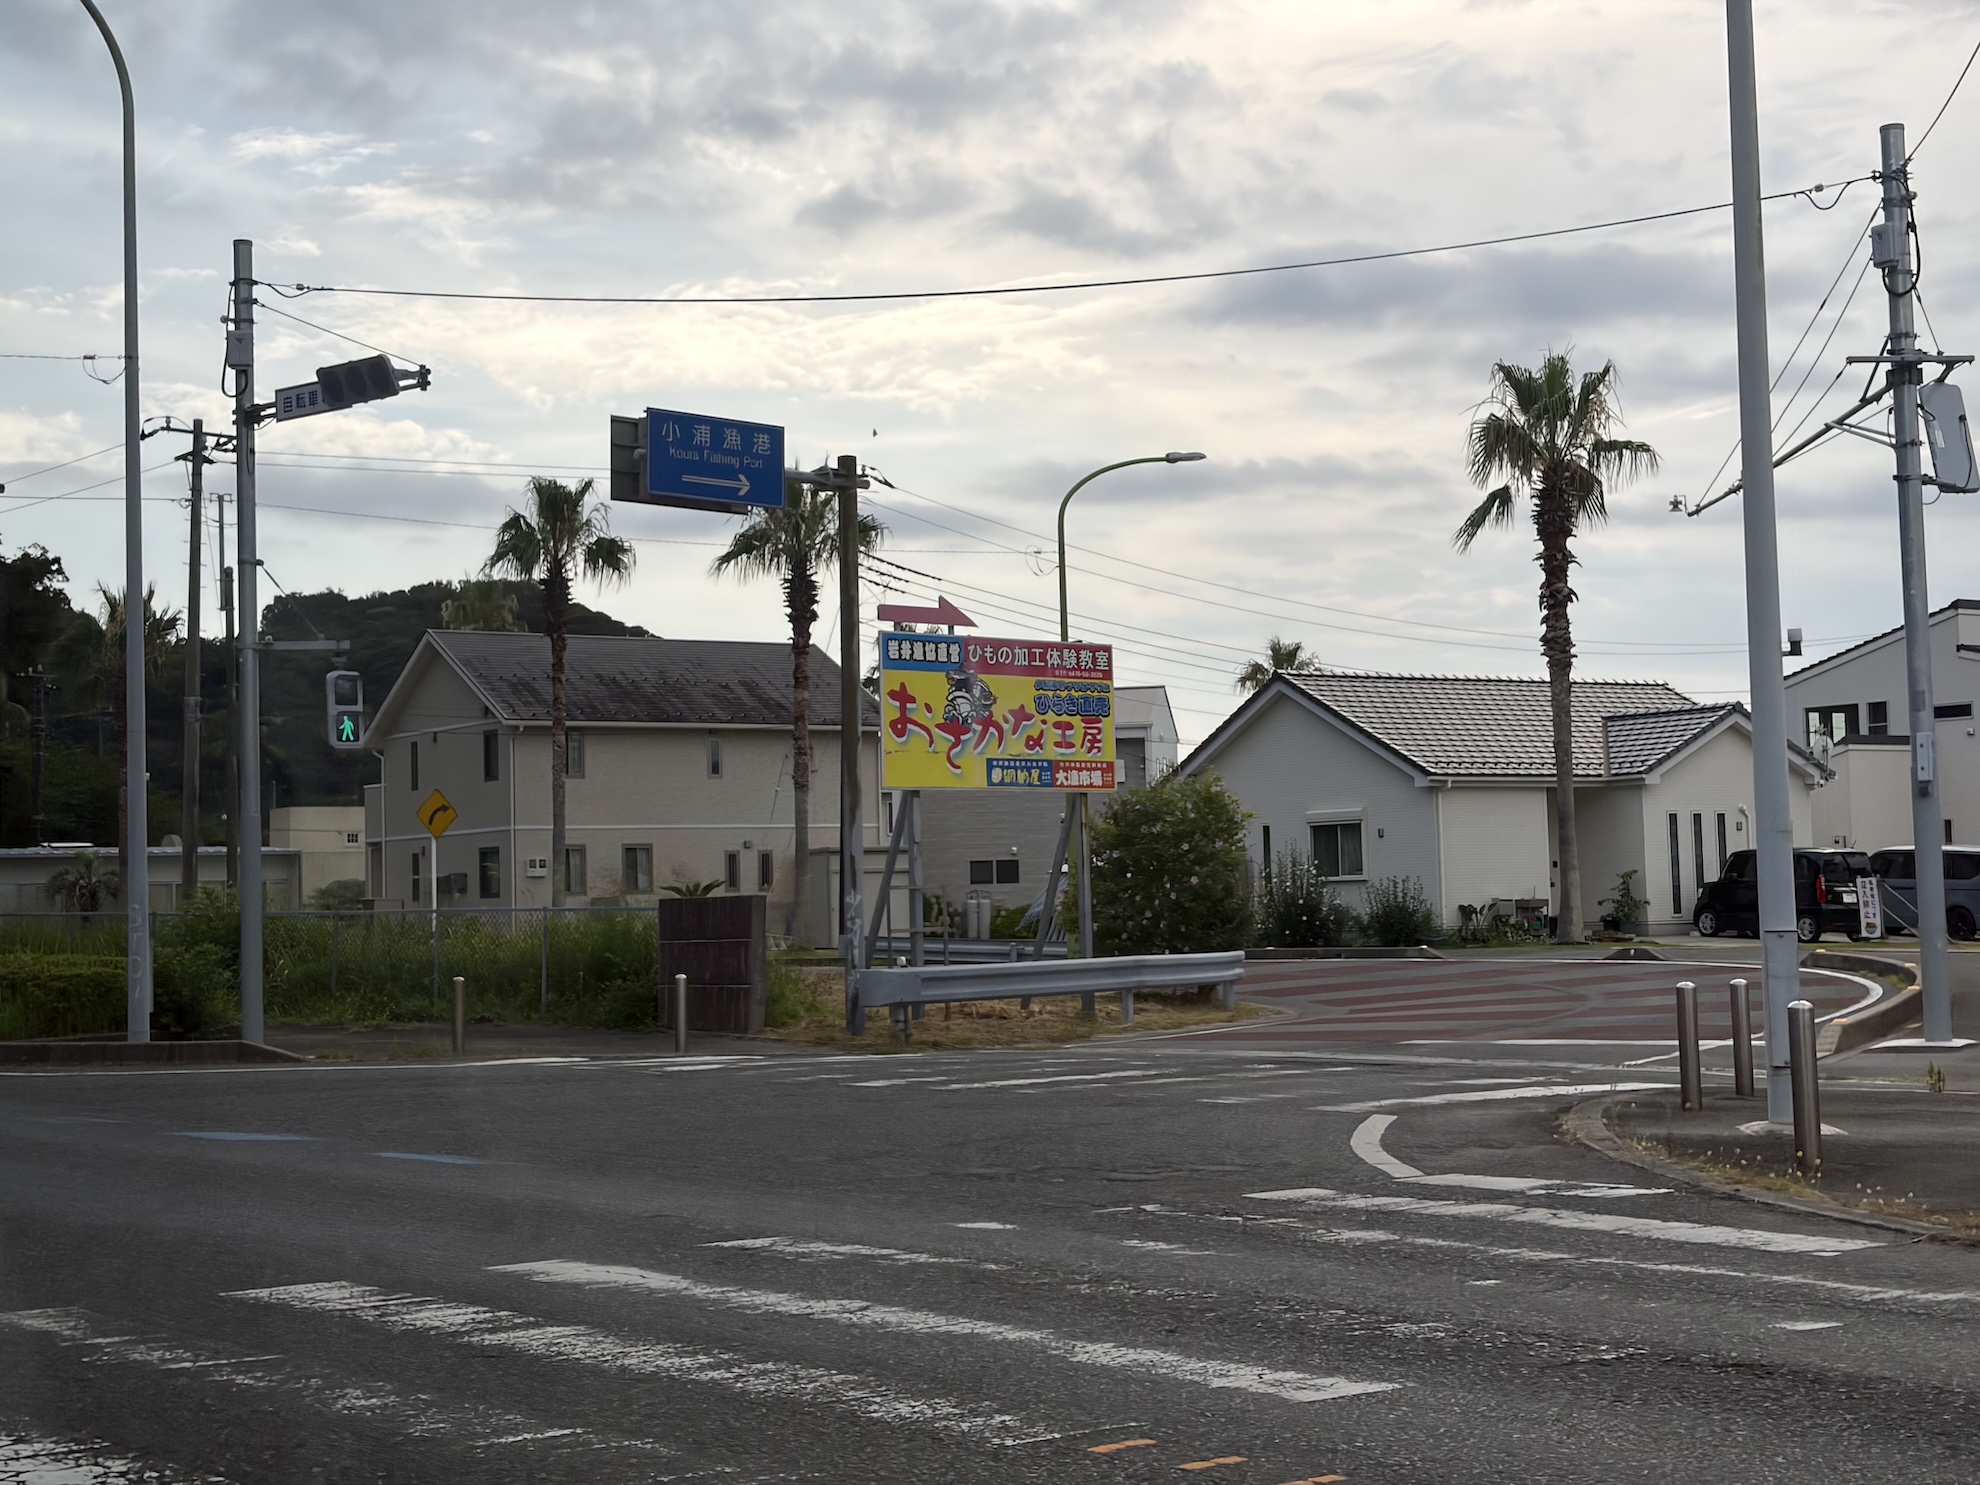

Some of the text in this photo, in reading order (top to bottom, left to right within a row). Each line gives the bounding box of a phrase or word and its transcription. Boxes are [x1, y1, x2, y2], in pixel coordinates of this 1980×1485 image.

[662, 420, 771, 455] 小浦漁港
[669, 446, 763, 469] Koura Fishing Port
[967, 645, 1110, 670] ひもの加工体験教室
[1034, 692, 1110, 717] ひらき直売
[887, 682, 1103, 774] おさかな工房
